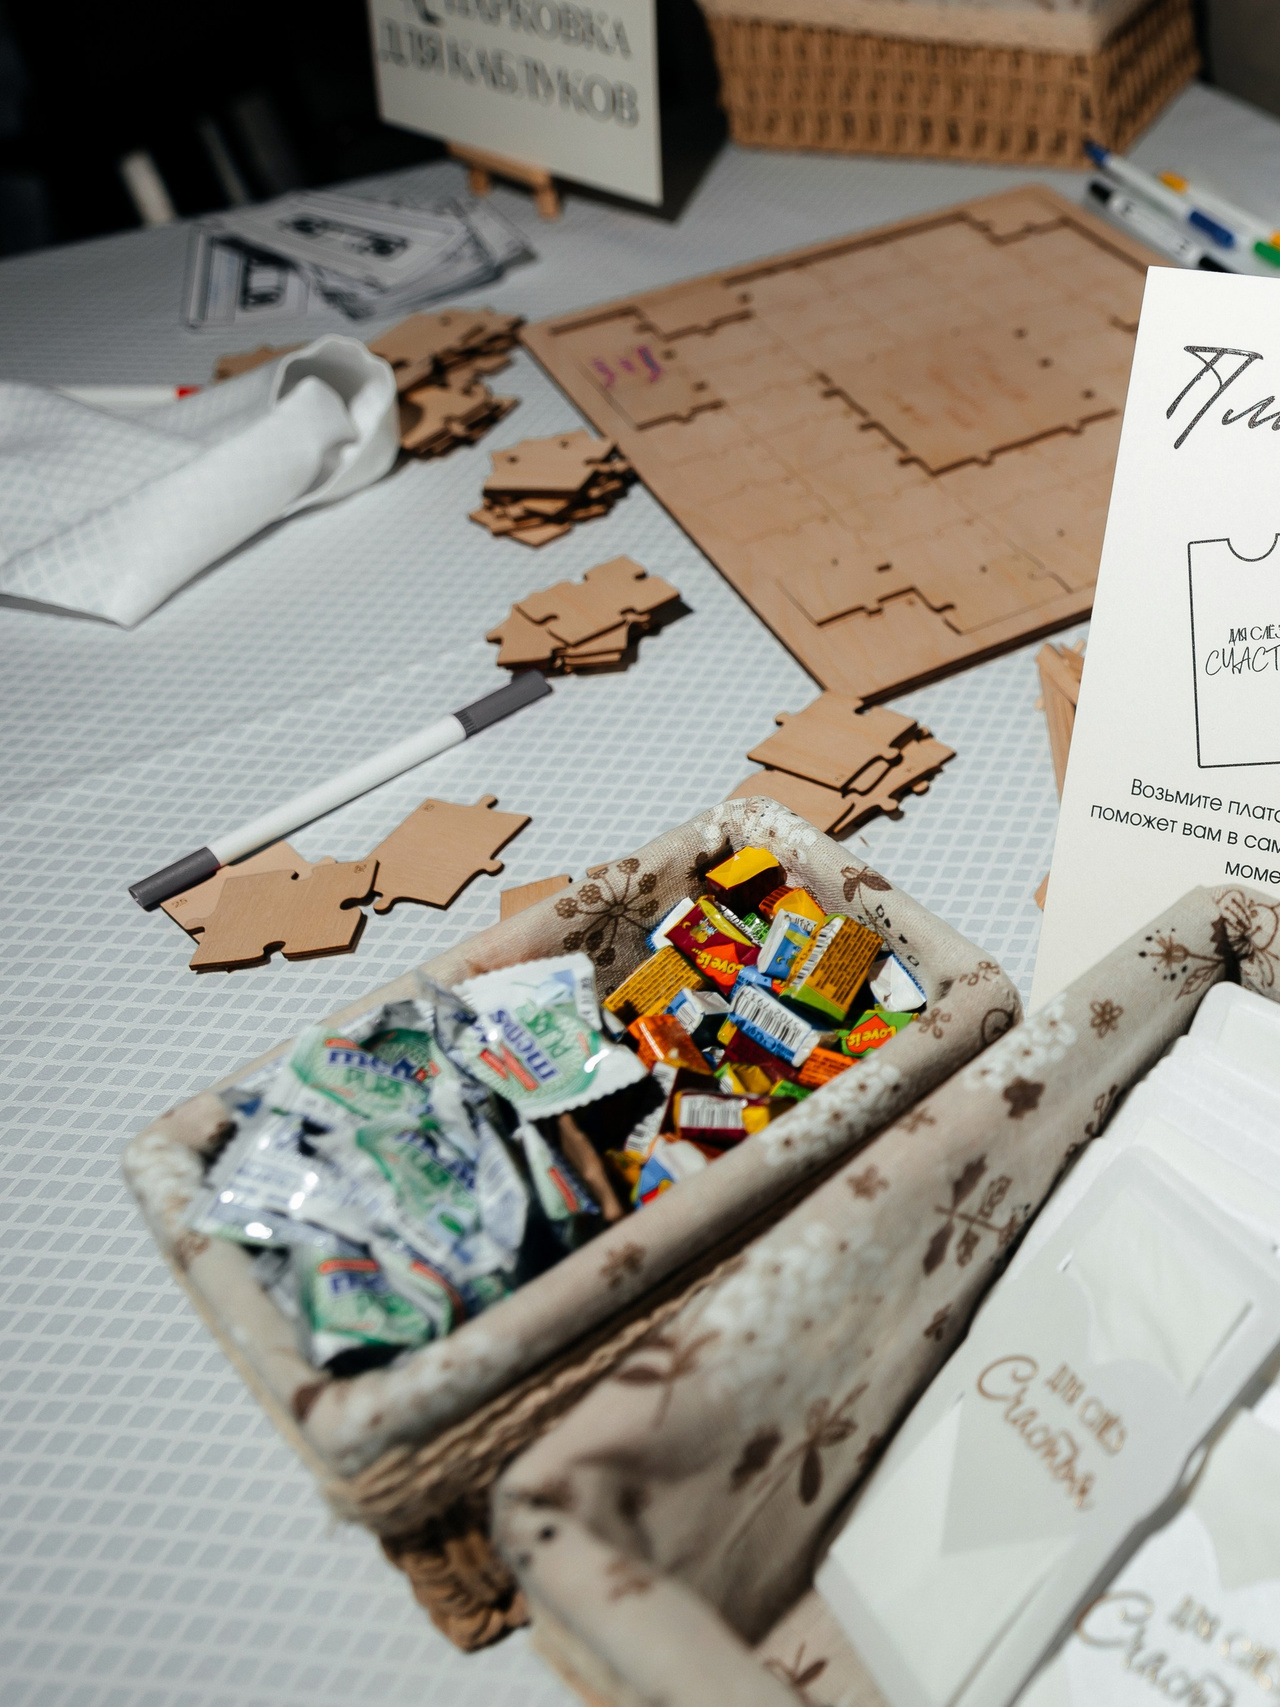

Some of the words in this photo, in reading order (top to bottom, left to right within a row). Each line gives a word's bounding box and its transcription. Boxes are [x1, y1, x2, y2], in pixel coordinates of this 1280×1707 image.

[1130, 778, 1223, 811] Возьмите
[1090, 804, 1178, 834] поможет
[1182, 823, 1222, 842] вам
[1227, 831, 1239, 845] в
[708, 952, 744, 982] Love
[862, 1025, 897, 1042] Love
